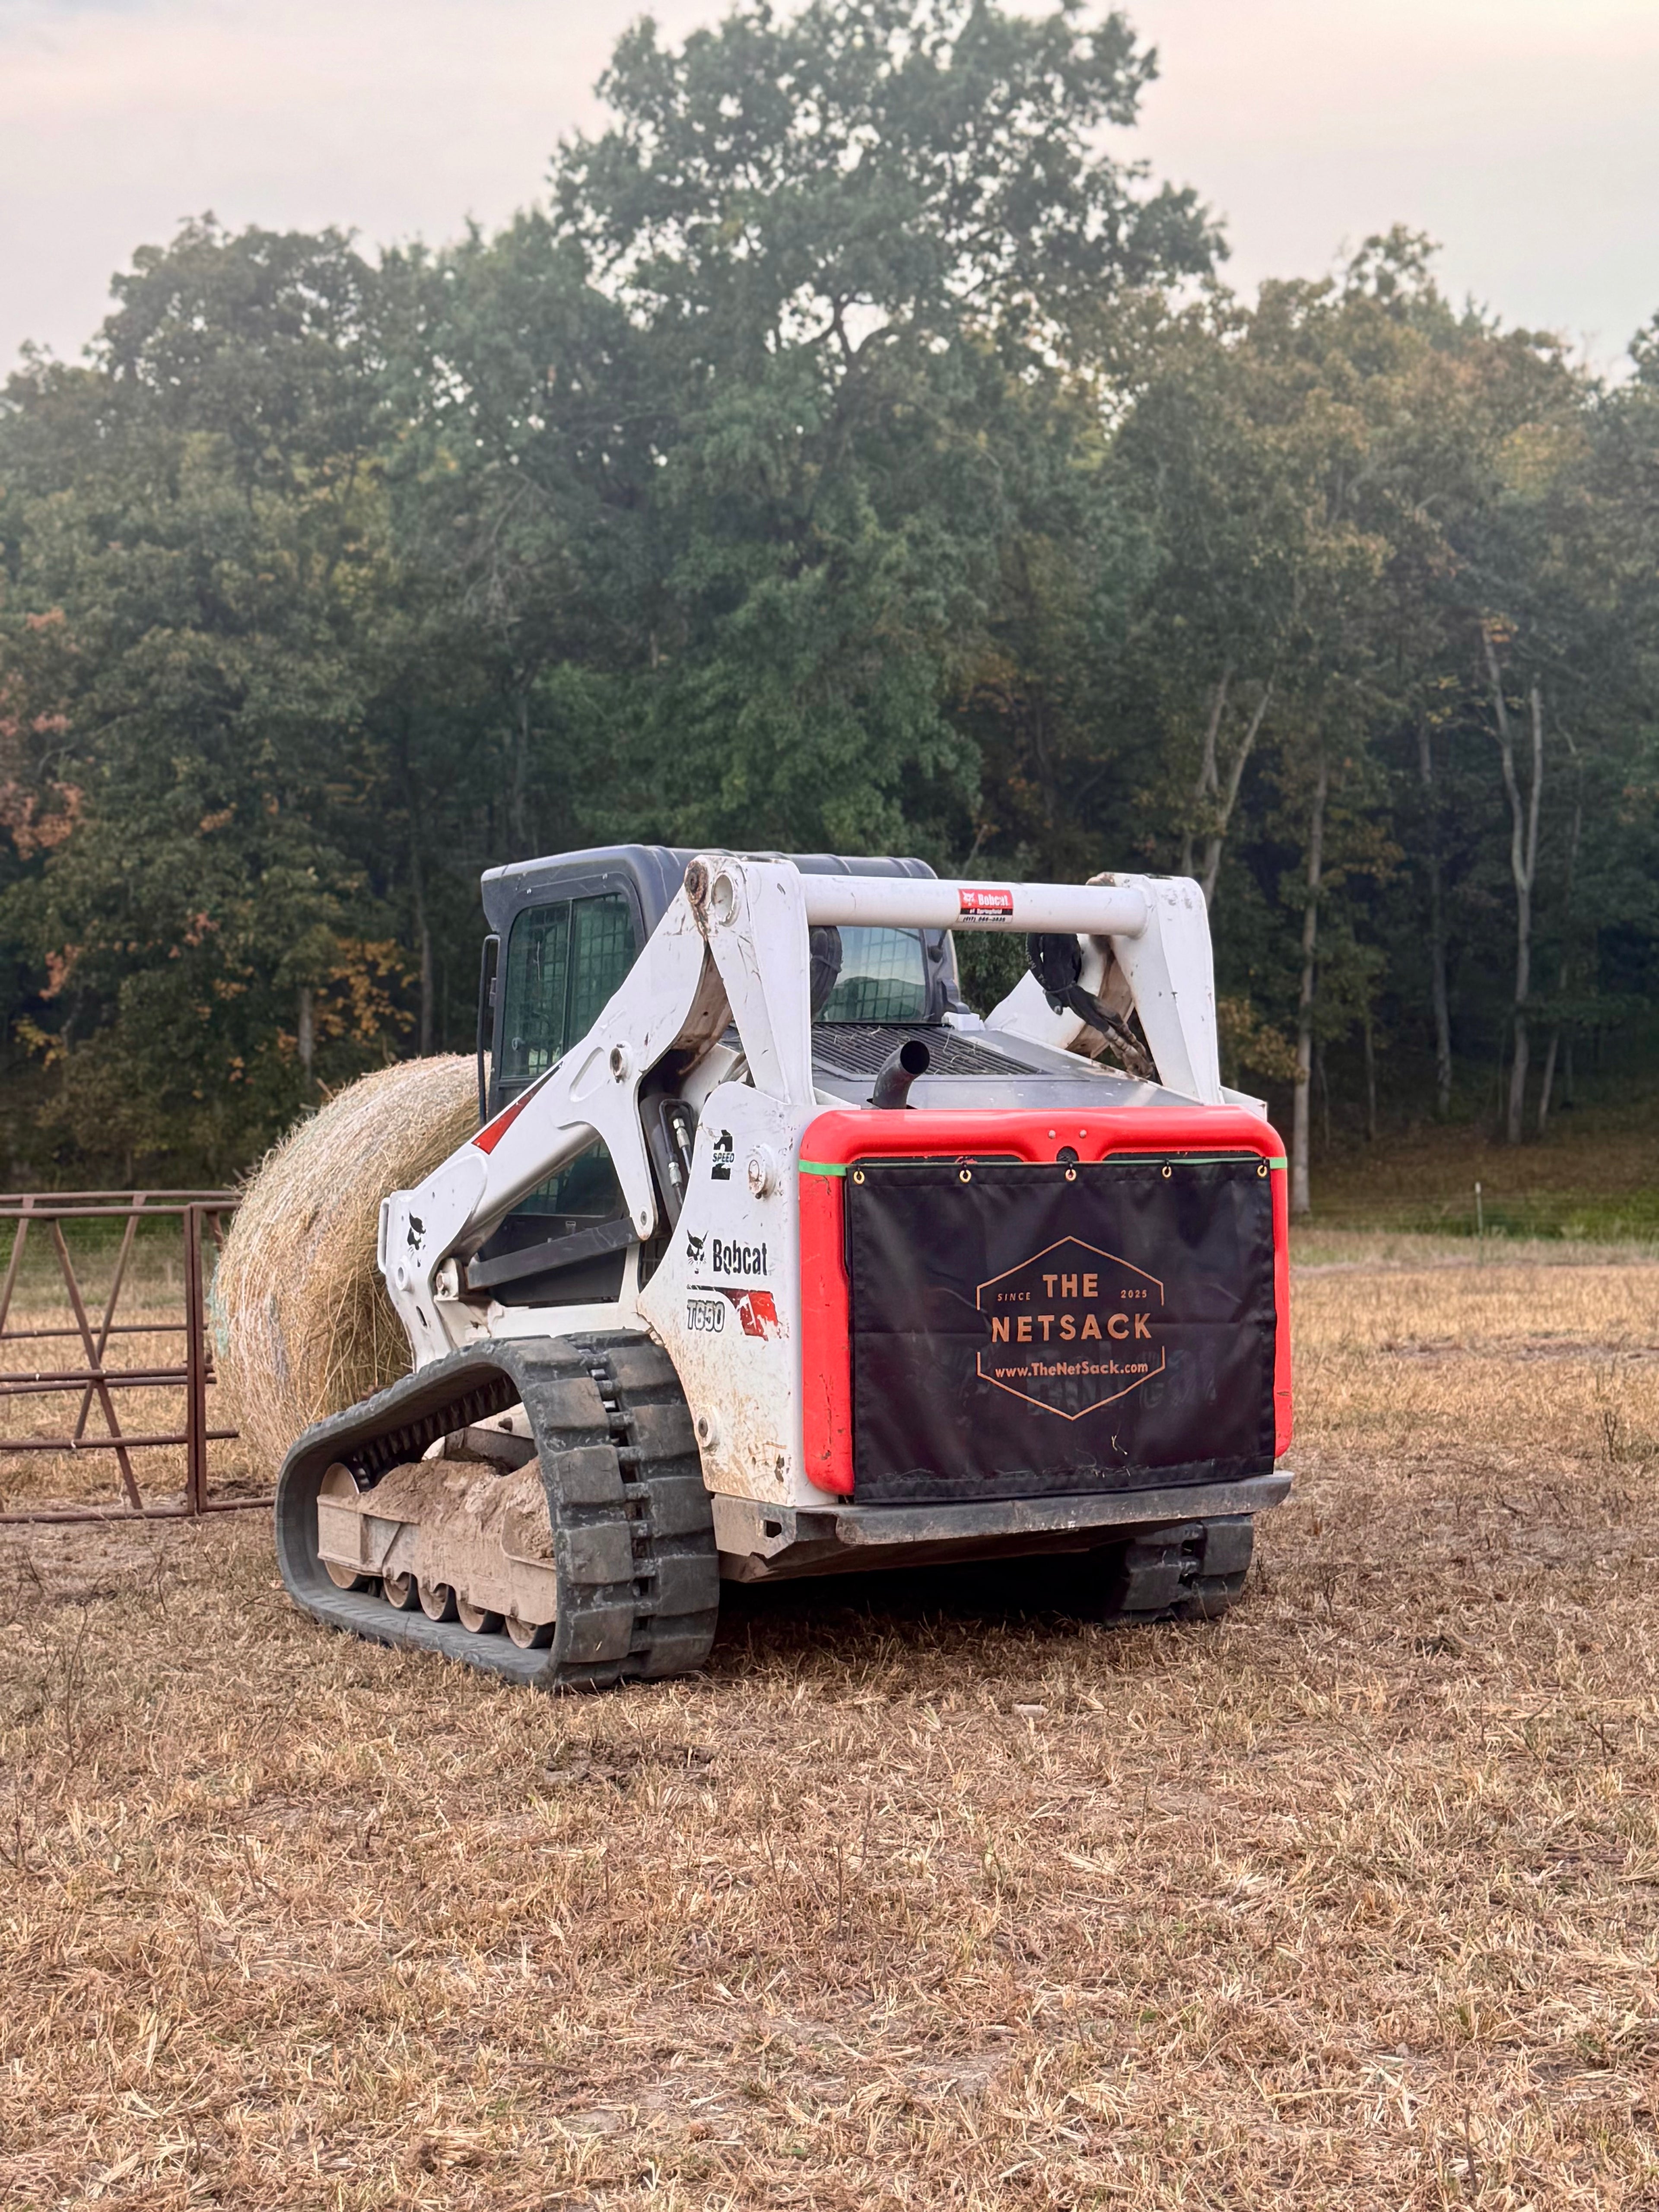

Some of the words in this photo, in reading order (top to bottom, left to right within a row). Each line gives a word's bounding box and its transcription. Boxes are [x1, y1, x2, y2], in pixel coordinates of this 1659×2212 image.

[978, 893, 1008, 906] Bobcat
[712, 1152, 734, 1163] SPEED
[713, 1239, 767, 1275] Bobcat
[1042, 1273, 1098, 1298] THE
[1120, 1290, 1147, 1299] 2025
[997, 1292, 1031, 1302] SINCE
[687, 1299, 725, 1333] T650
[992, 1313, 1152, 1343] NETSACK
[995, 1360, 1148, 1378] www.TheNetSack.com
